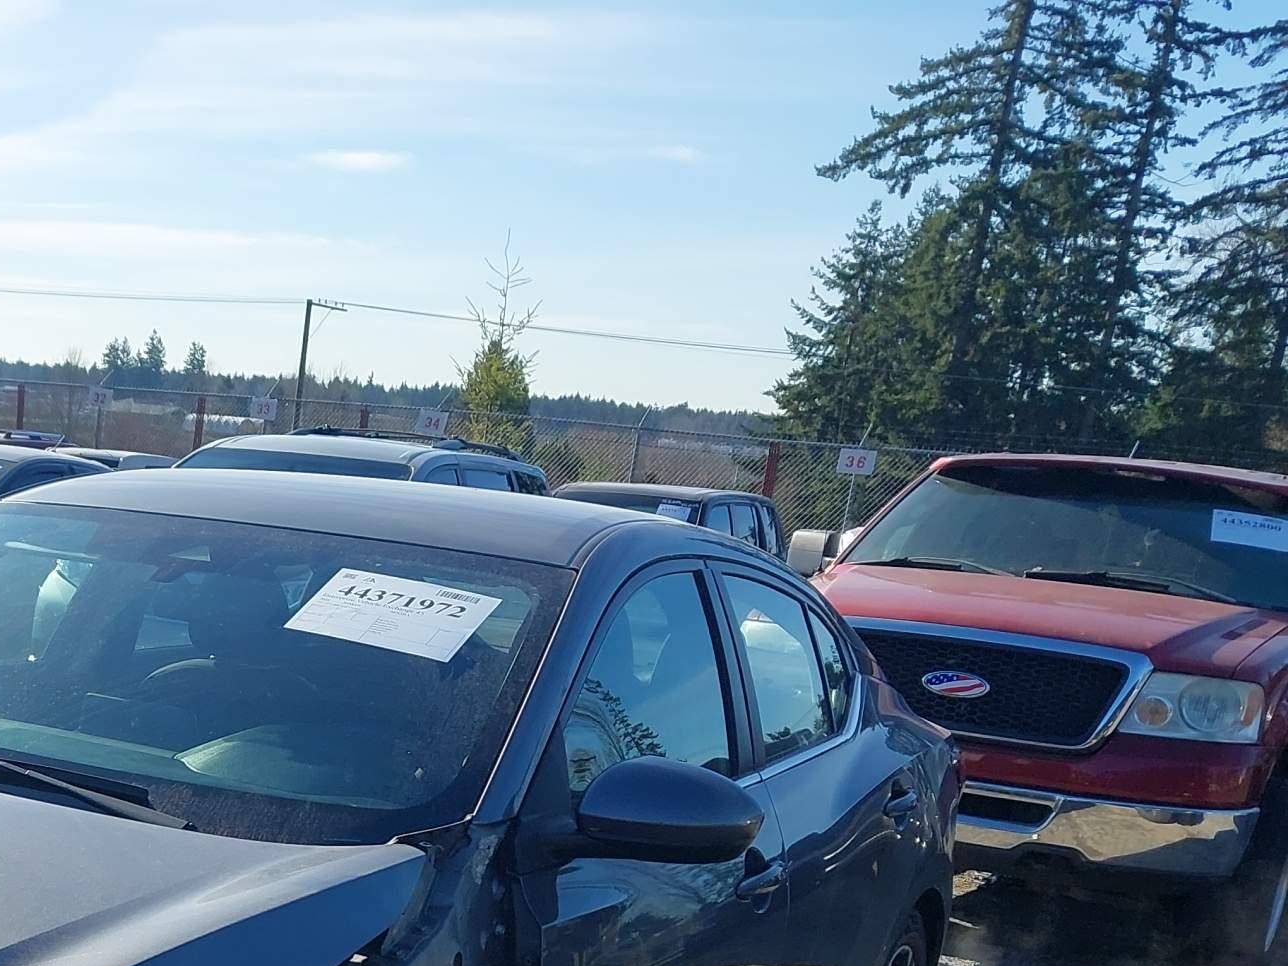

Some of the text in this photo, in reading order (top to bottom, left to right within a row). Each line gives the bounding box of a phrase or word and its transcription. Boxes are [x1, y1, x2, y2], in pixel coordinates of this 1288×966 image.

[424, 416, 440, 430] 34
[845, 455, 867, 468] 36
[338, 584, 467, 618] 44371972
